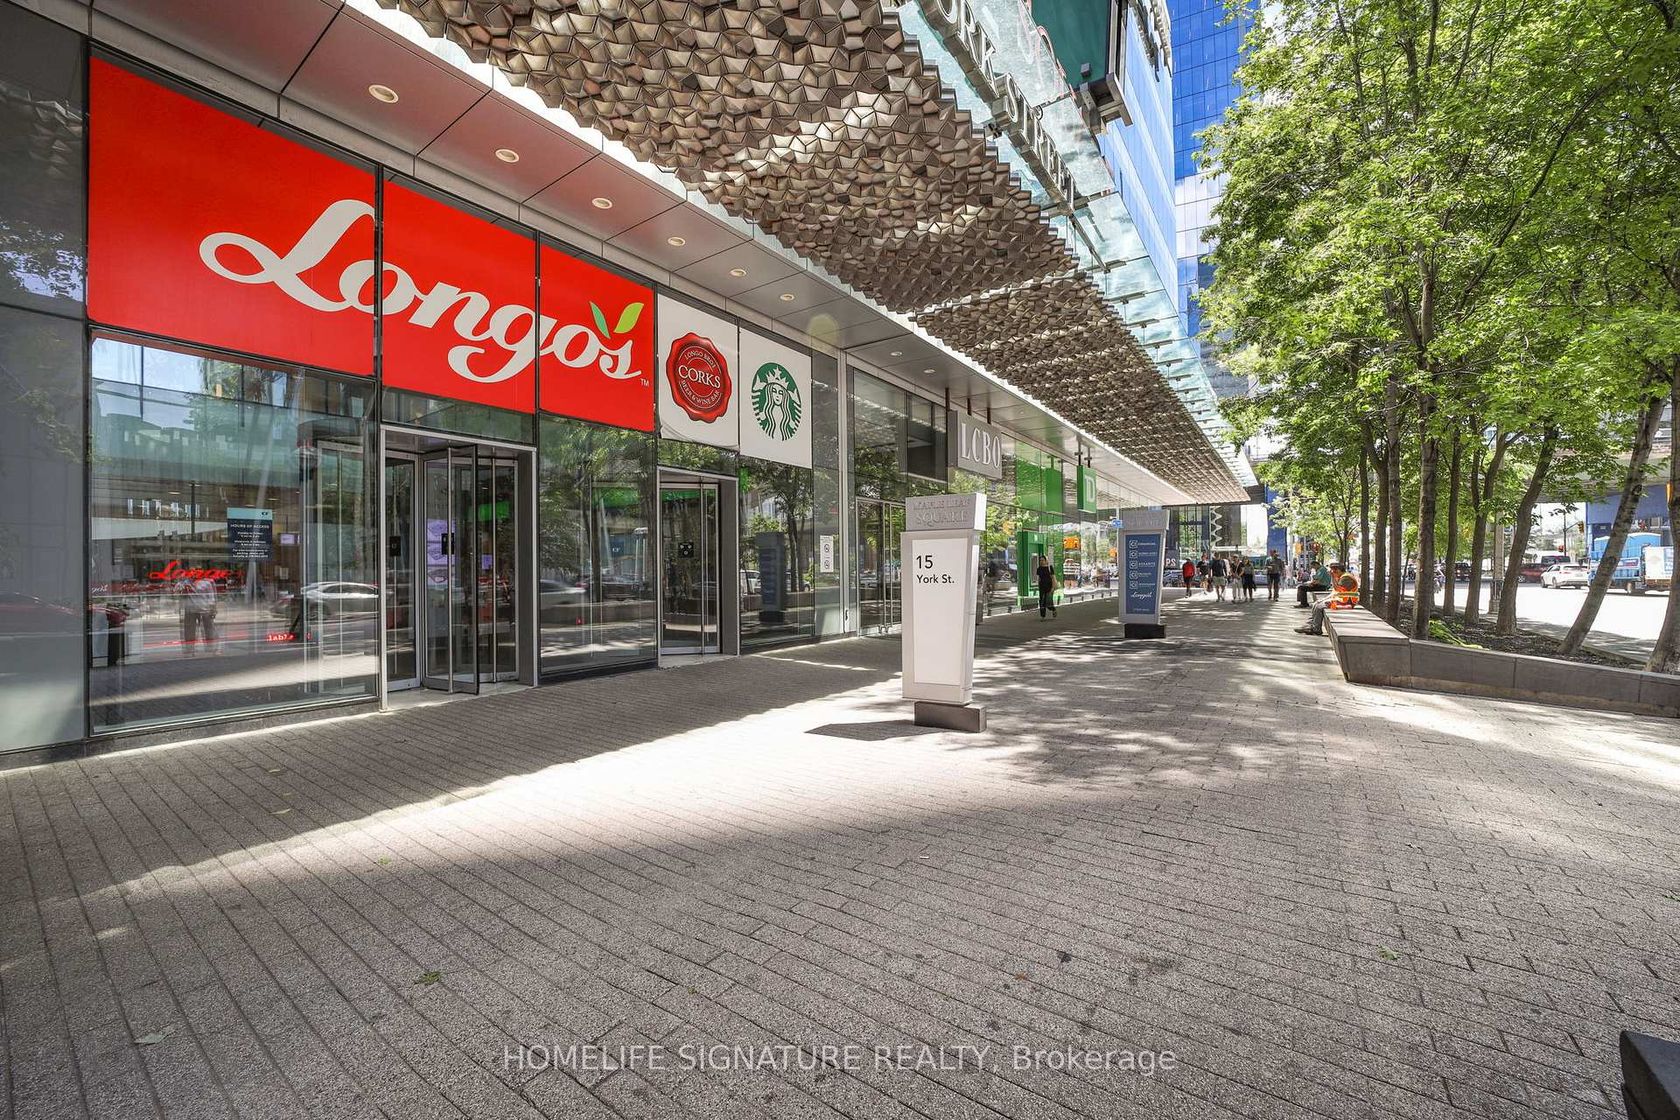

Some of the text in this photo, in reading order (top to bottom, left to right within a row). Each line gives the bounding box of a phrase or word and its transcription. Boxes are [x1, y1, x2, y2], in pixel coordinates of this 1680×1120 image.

[678, 364, 721, 389] CORKS
[961, 423, 1001, 469] LCBO
[915, 510, 968, 527] SQUARE
[916, 555, 934, 569] 15
[917, 574, 955, 584] York St.
